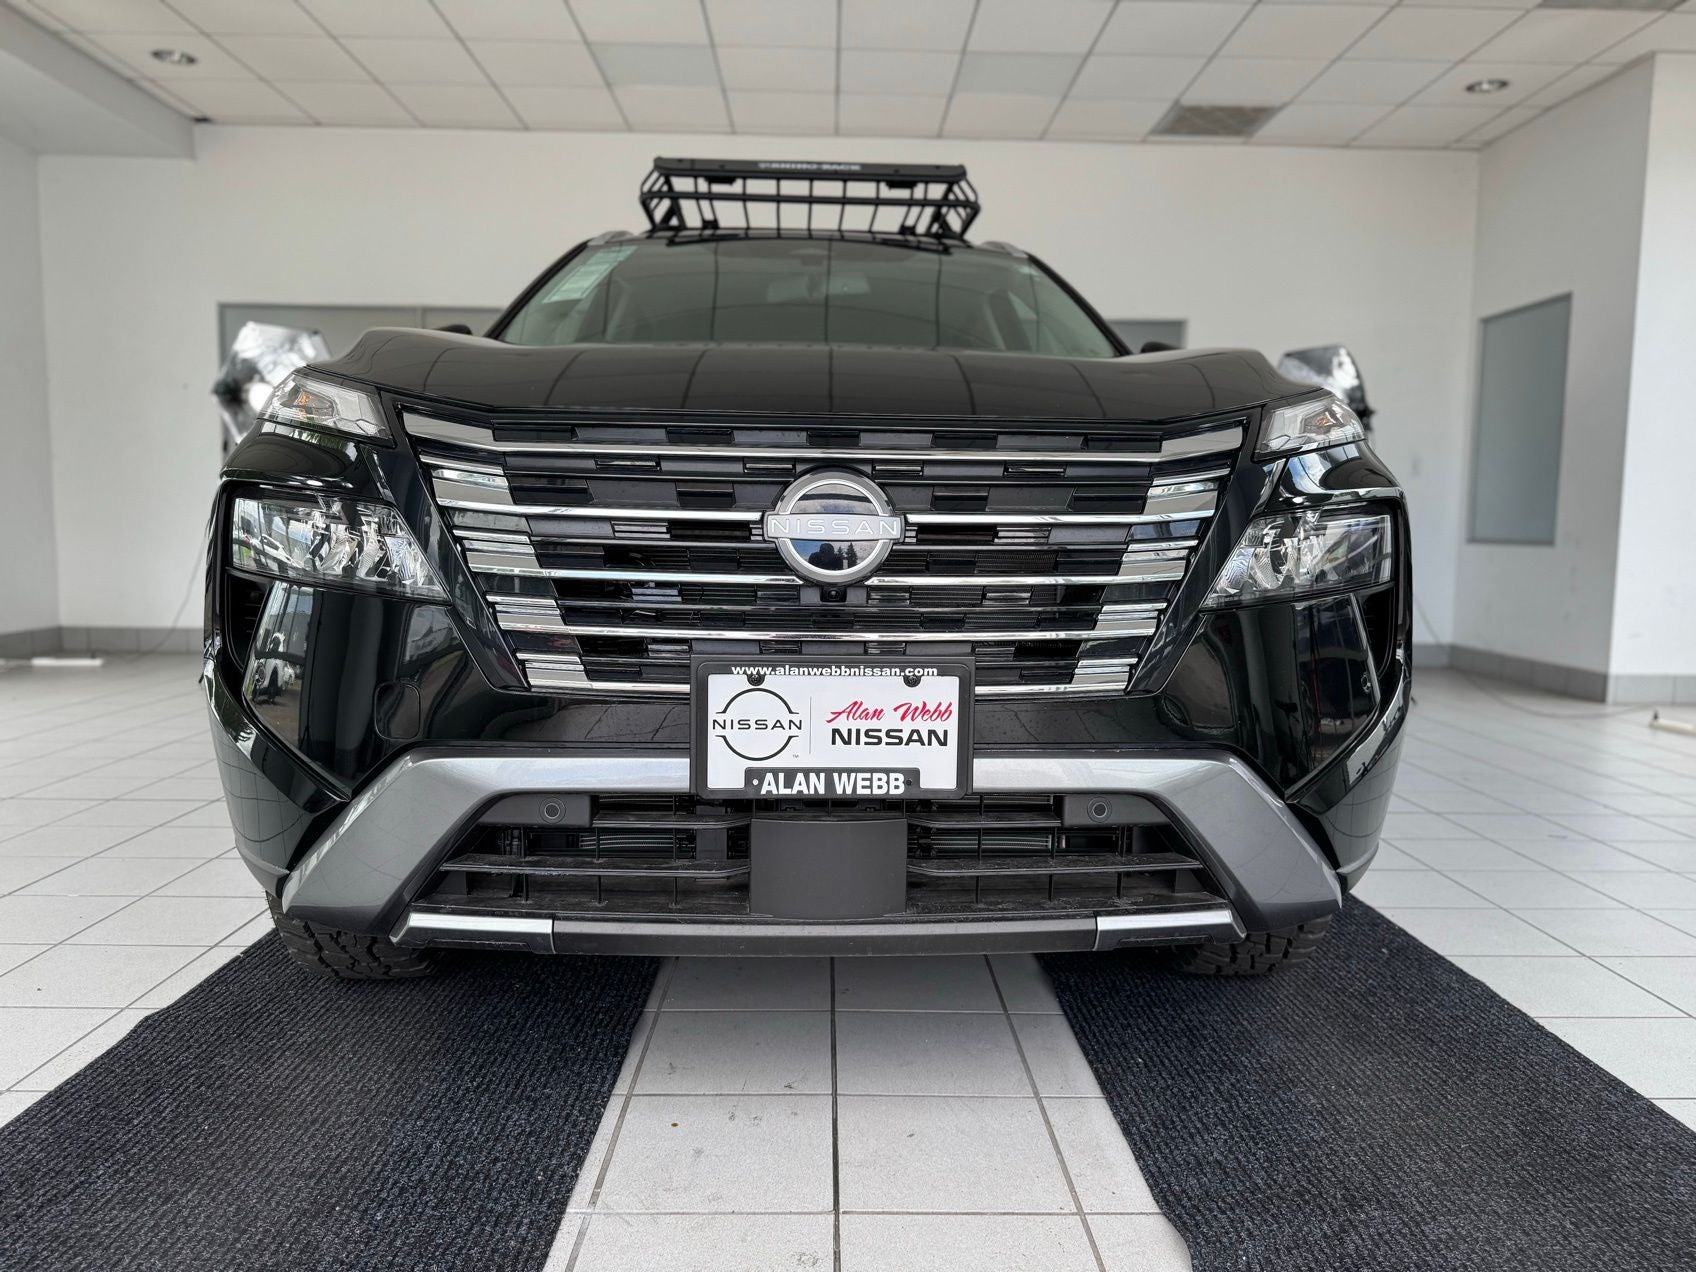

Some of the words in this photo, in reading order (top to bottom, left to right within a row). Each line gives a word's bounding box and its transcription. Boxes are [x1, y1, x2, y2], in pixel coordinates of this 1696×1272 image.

[771, 518, 897, 535] NISSAN
[731, 665, 938, 677] www.alanwebbnissan.com
[825, 700, 886, 724] Alan
[893, 700, 953, 722] Webb
[712, 719, 802, 731] NISSAN
[831, 728, 948, 747] NISSAN
[760, 772, 826, 795] ALAN
[832, 772, 905, 795] WEBB
